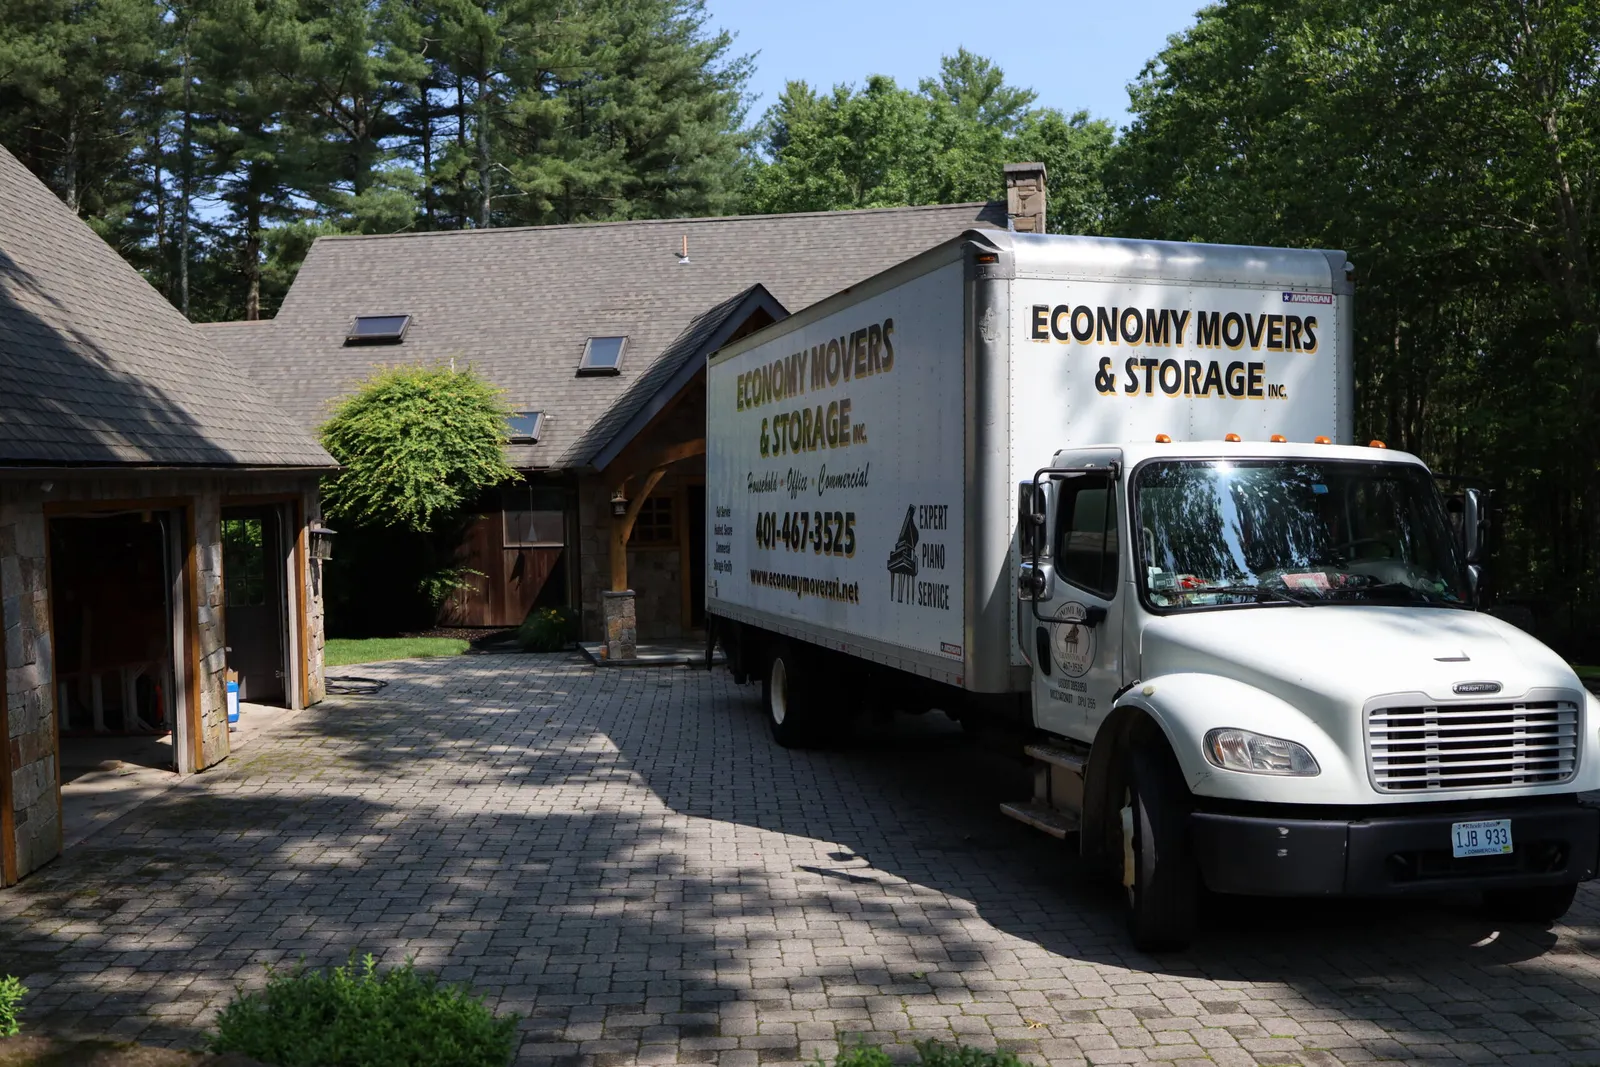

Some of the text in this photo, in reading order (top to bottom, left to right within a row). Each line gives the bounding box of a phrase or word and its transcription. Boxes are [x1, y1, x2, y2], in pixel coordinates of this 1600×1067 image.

[1292, 294, 1330, 303] MORGAN
[1031, 304, 1319, 353] ECONOMY MOVERS
[737, 318, 894, 411] ECONOMY MOVERS
[1095, 356, 1288, 400] & STORAGE INC.
[760, 398, 868, 458] & STORAGE INC.
[747, 461, 870, 499] Household Office Commercial
[755, 511, 857, 559] 401-467-3525
[919, 504, 948, 530] EXPERT
[922, 543, 945, 570] PIANO
[750, 568, 860, 605] www.economymoversri.net
[918, 581, 950, 610] SERVICE
[1456, 828, 1508, 848] 1JB 933
